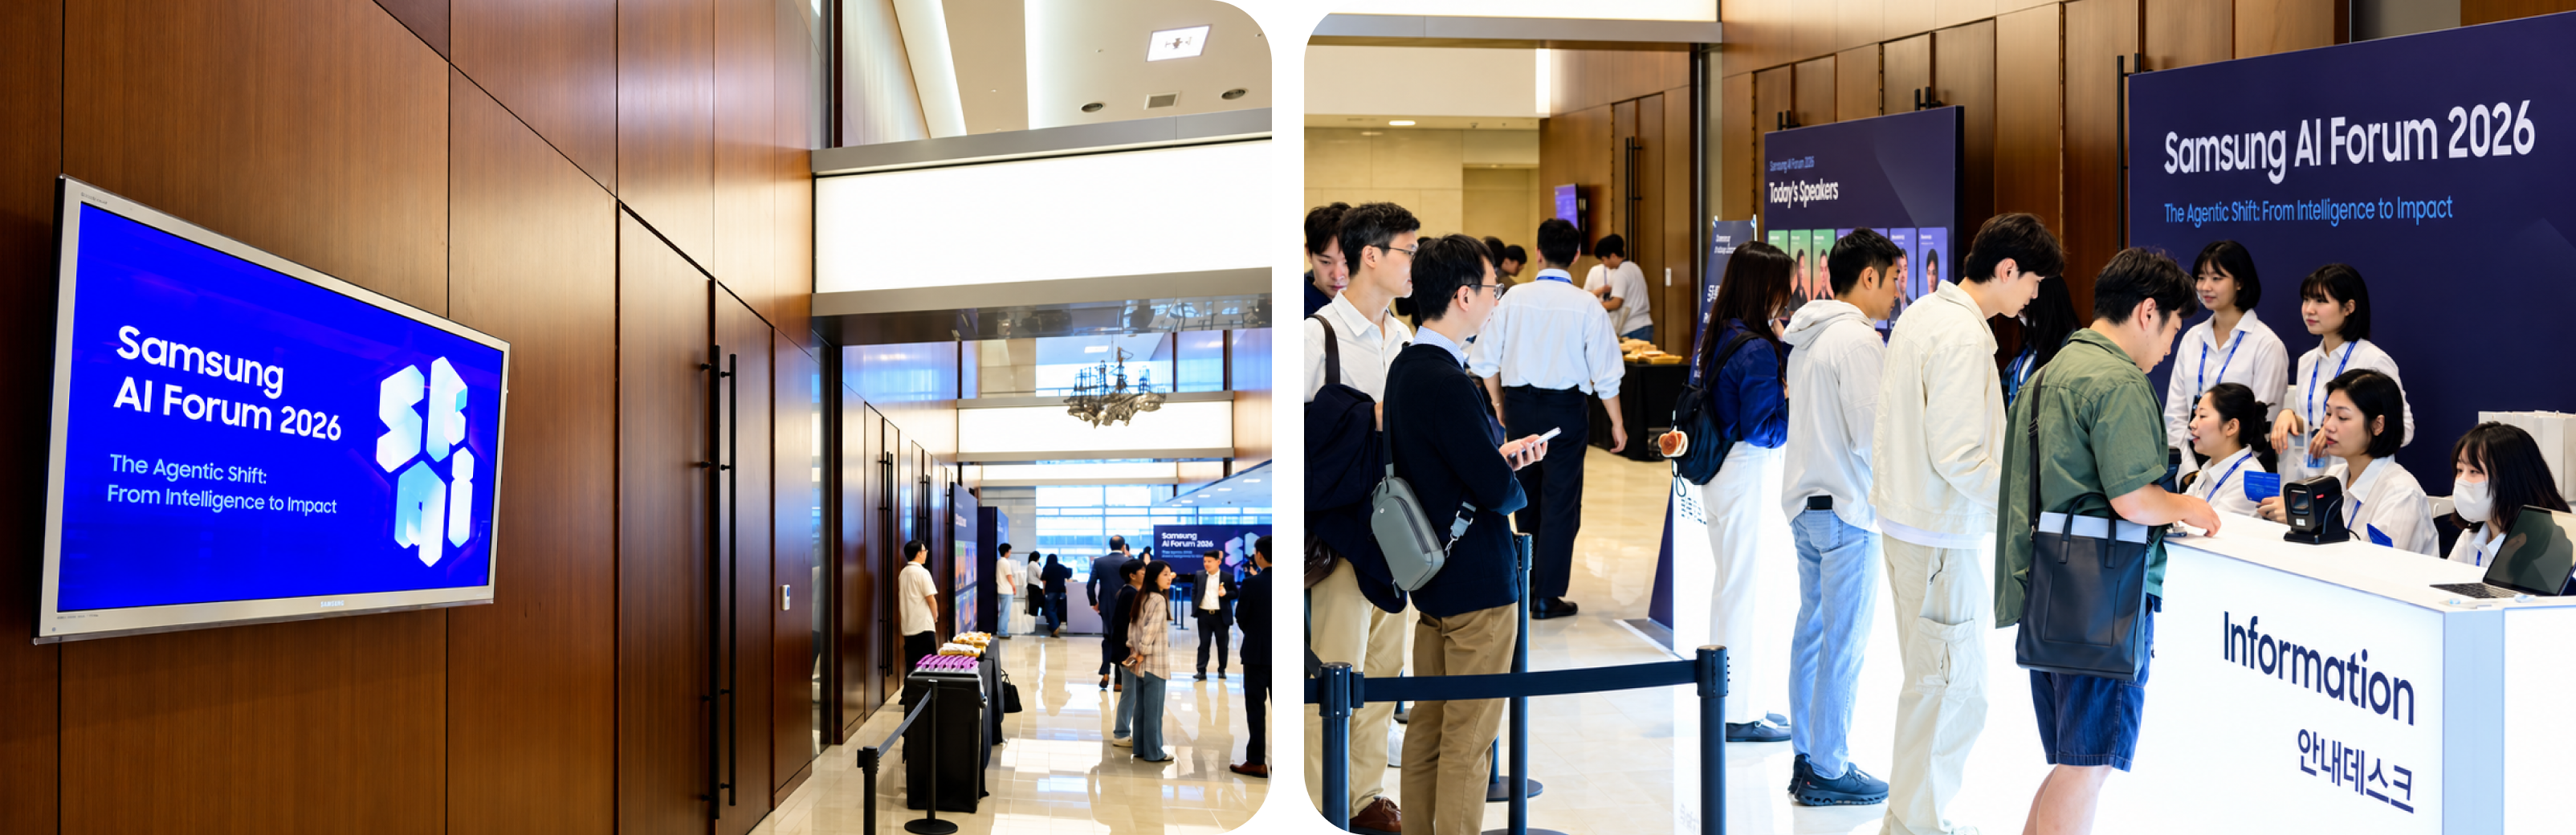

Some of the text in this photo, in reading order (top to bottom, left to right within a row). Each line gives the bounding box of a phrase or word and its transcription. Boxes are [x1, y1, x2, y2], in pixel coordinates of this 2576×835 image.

[2164, 99, 2536, 185] Samsung AI Forum 2026
[1769, 177, 1839, 210] Today's Speakers
[2164, 195, 2453, 229] The Agentic Shift: From Intelligence to Impact
[116, 325, 284, 400] Samsung
[112, 376, 342, 441] AI Forum 2026
[109, 454, 267, 485] The Agentic Shift:
[107, 484, 337, 517] From Intelligence to Impact
[1161, 532, 1197, 540] Samsung
[2223, 610, 2415, 727] Information
[2297, 727, 2415, 815] 안내데스크
